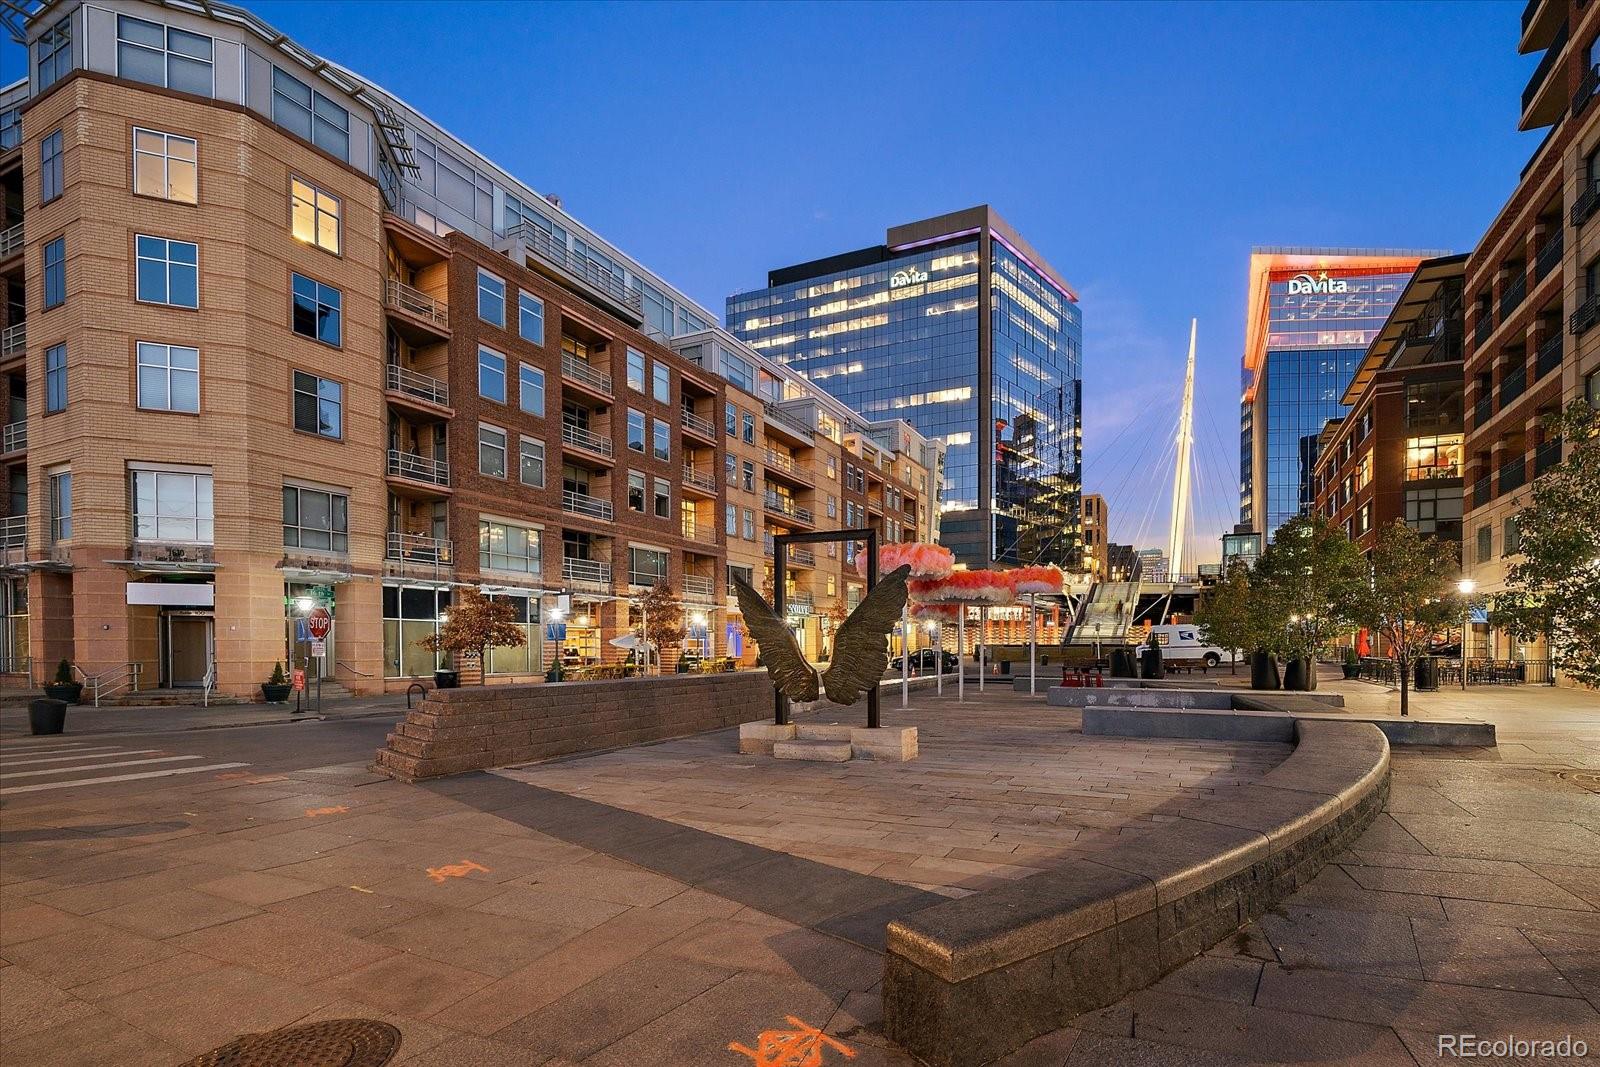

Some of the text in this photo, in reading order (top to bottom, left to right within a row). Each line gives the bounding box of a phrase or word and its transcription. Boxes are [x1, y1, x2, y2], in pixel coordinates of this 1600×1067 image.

[890, 267, 928, 288] DaVita
[1288, 272, 1347, 295] DaVita
[310, 616, 329, 629] STOP
